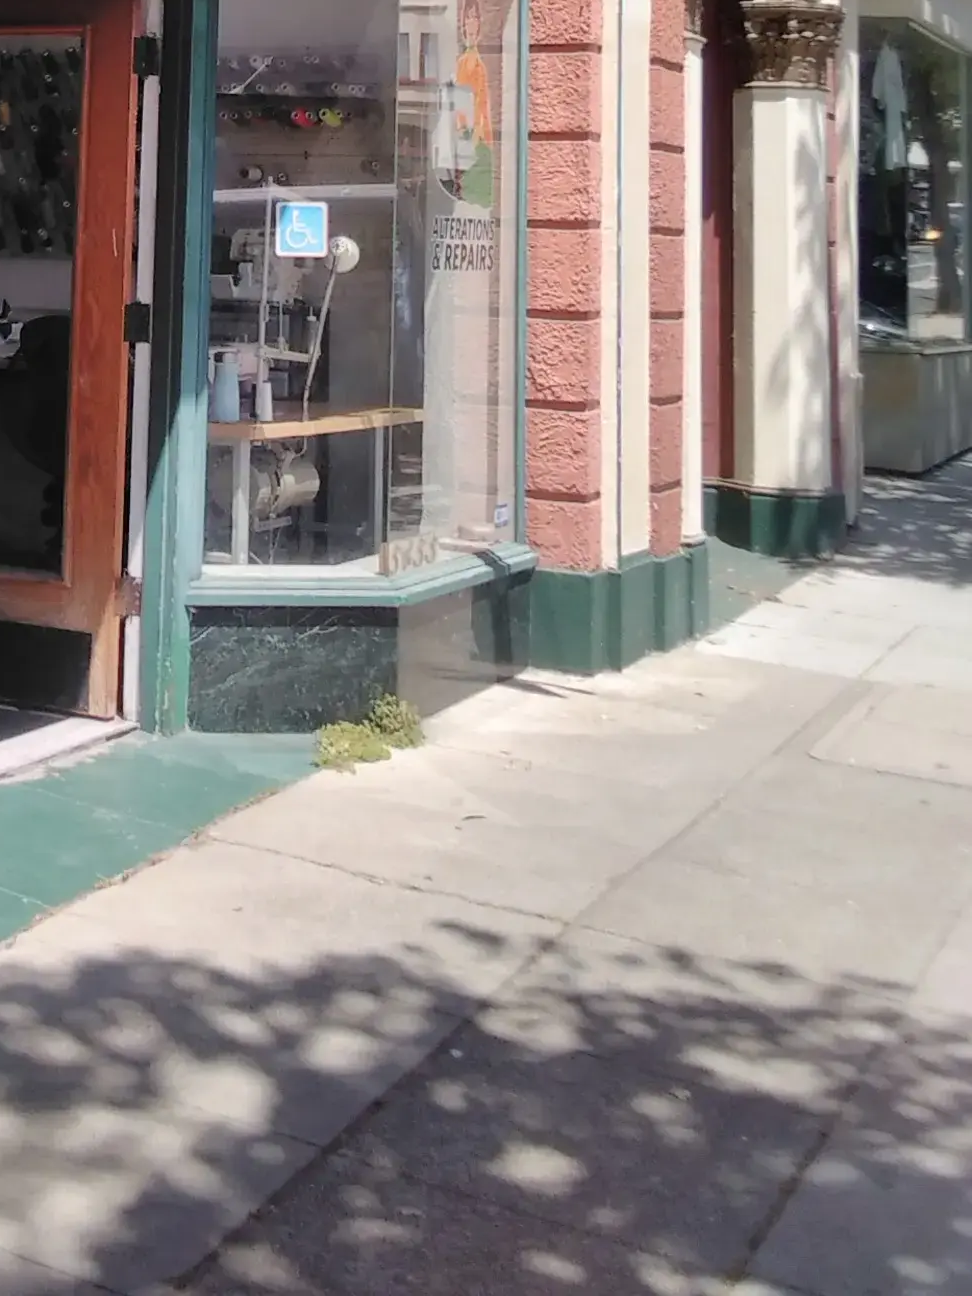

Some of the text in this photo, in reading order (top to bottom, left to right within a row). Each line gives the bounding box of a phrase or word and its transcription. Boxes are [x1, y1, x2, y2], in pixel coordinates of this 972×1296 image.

[432, 216, 495, 241] ALTERATIONS
[431, 243, 494, 271] & REPAIRS
